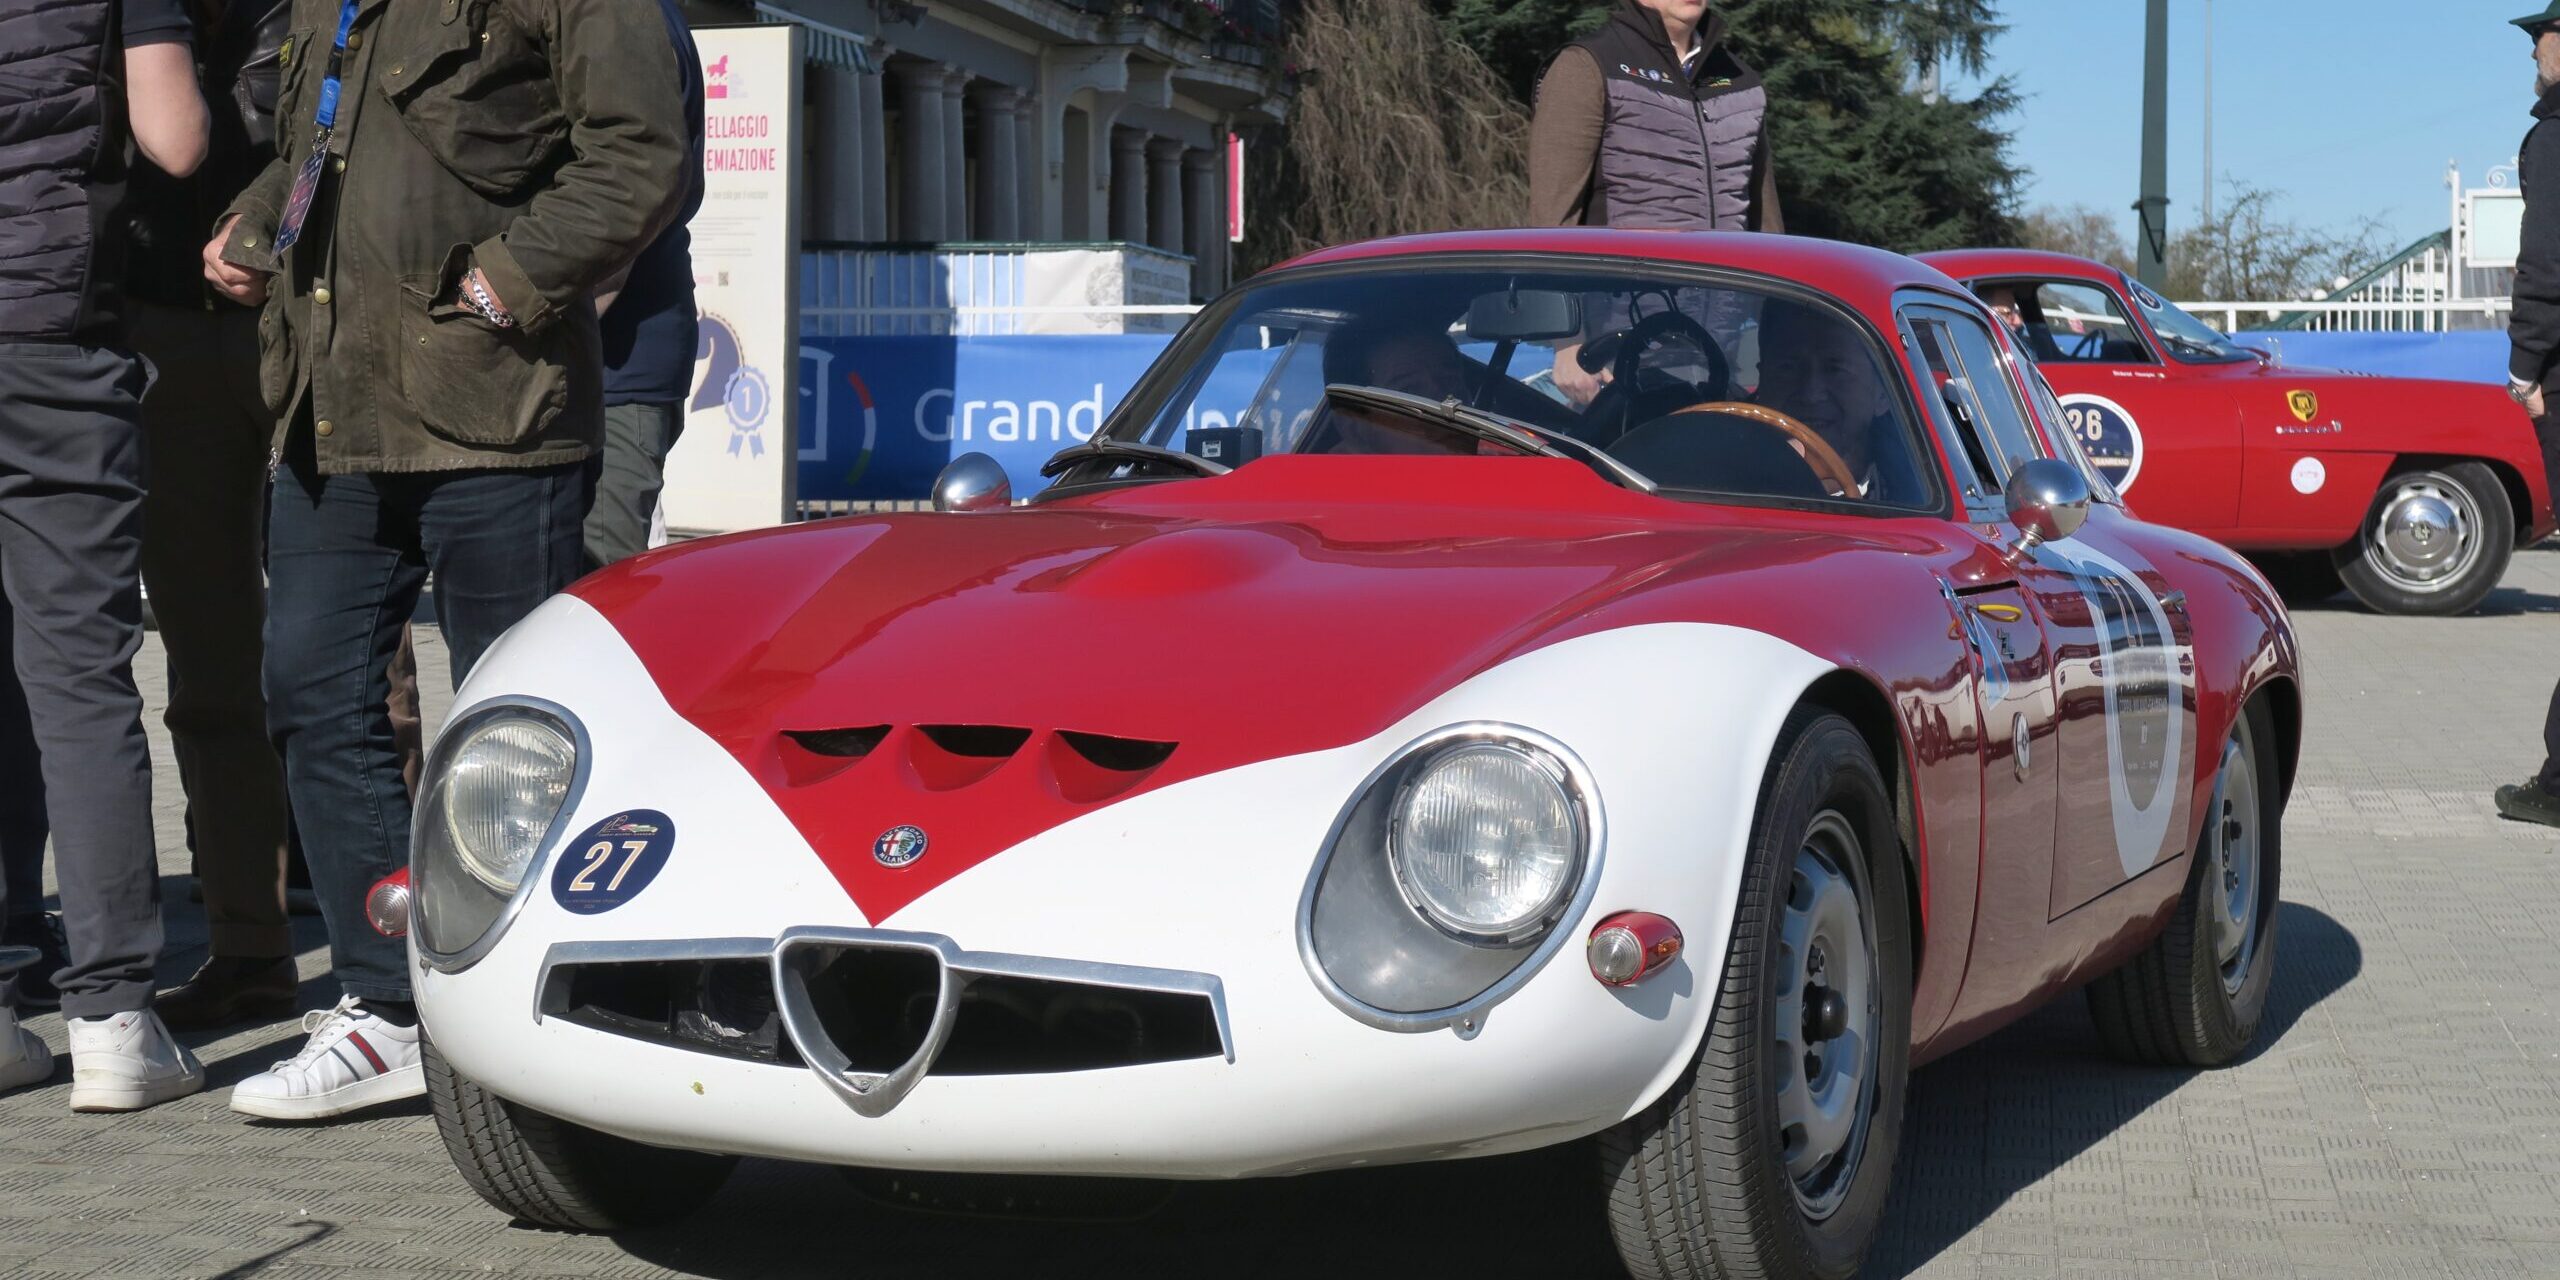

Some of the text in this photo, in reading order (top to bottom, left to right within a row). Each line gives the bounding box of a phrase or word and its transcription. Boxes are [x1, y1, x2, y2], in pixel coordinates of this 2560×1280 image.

[706, 115, 769, 138] ELLAGGIO
[706, 148, 776, 171] EMIAZIONE
[741, 385, 751, 413] 1
[914, 383, 1104, 442] Grand
[2067, 408, 2103, 442] 26
[568, 841, 649, 892] 27
[879, 852, 911, 863] MILANO
